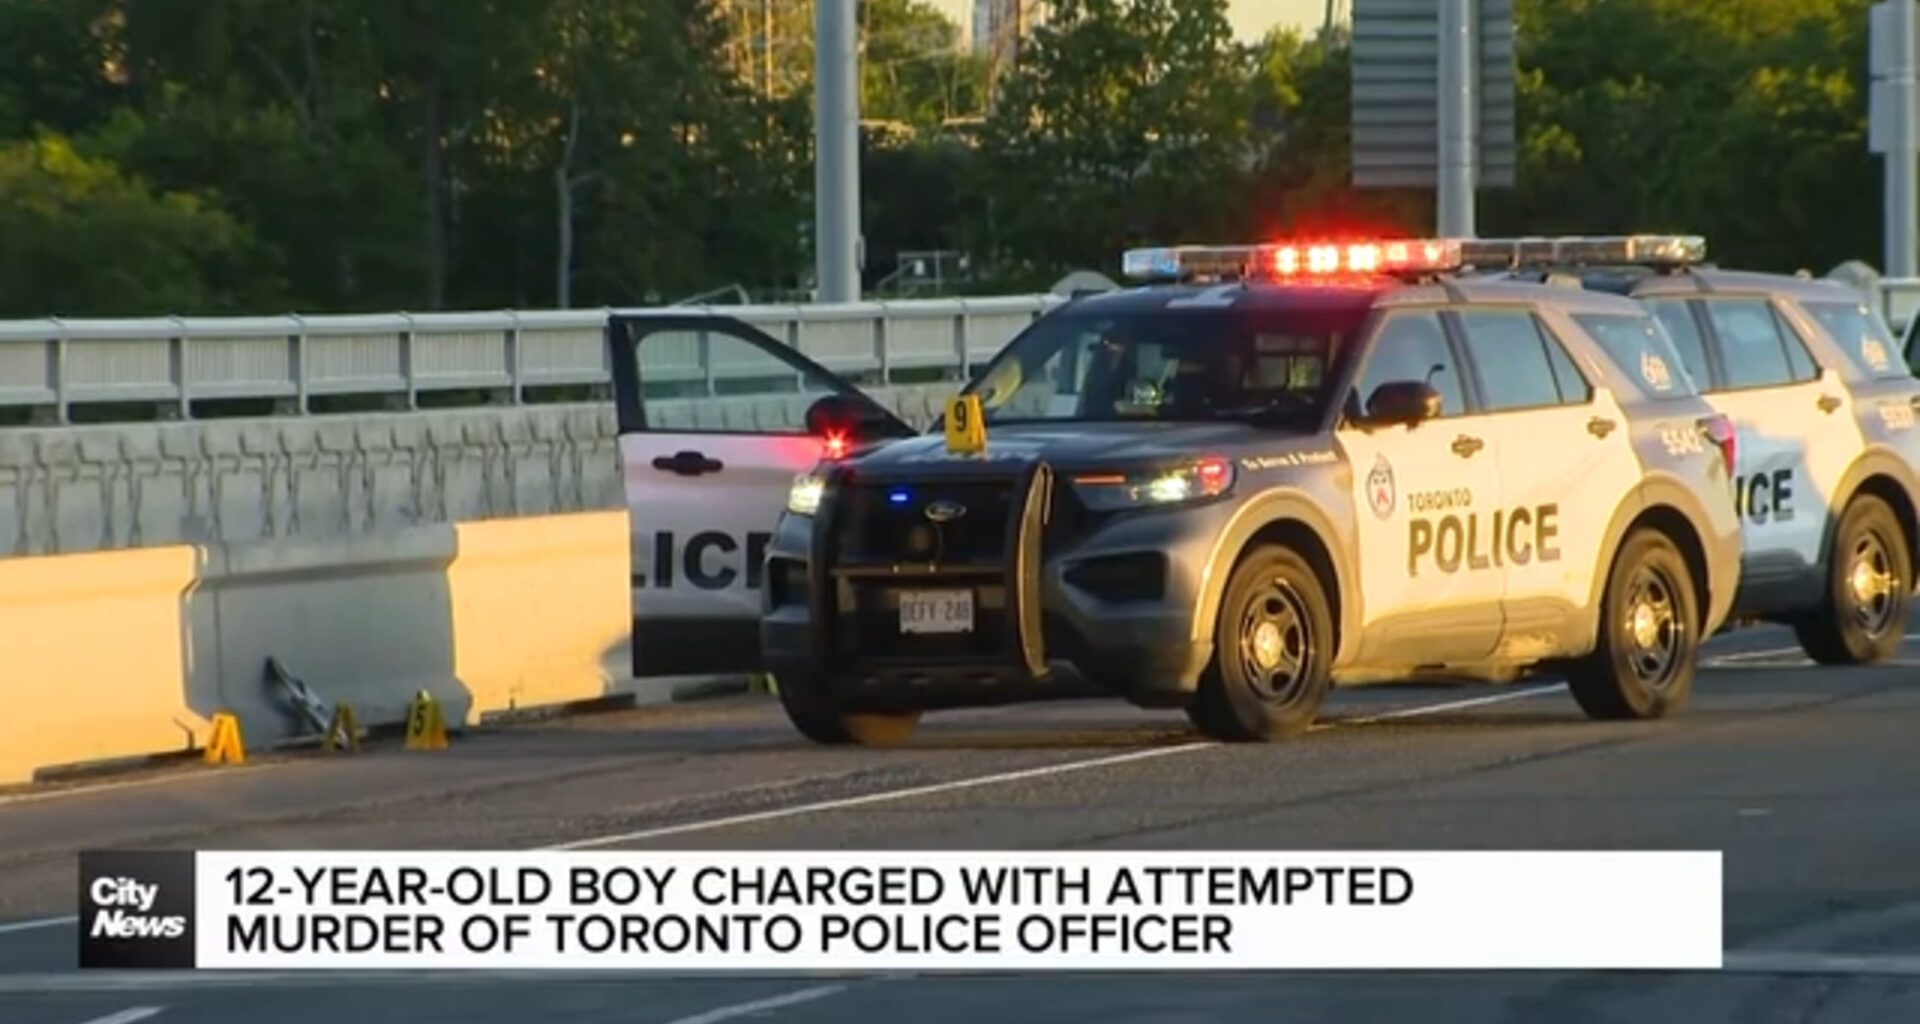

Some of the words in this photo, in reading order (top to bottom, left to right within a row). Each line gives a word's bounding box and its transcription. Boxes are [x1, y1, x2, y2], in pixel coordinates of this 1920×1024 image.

[954, 401, 967, 432] 9
[1408, 487, 1472, 512] TORONTO
[1408, 503, 1561, 578] POLICE
[632, 530, 773, 591] IC
[414, 704, 426, 736] 5
